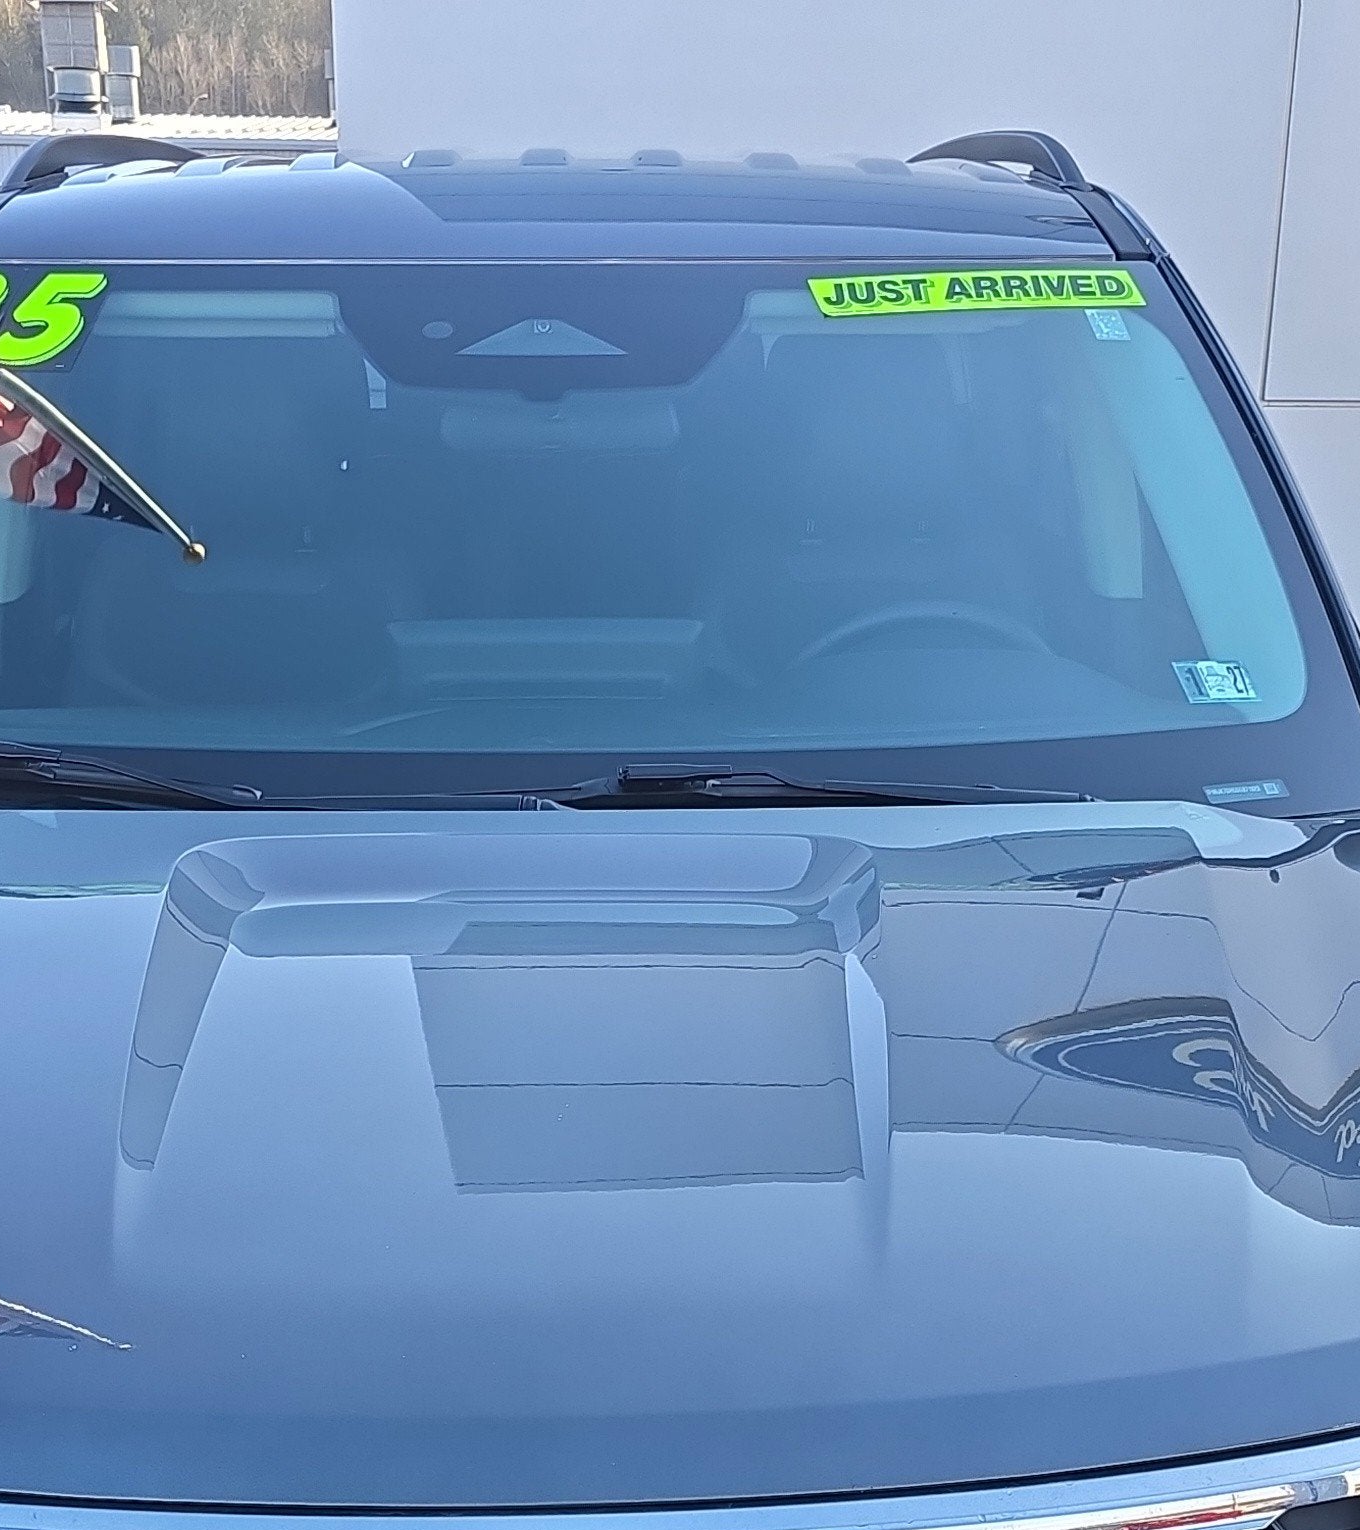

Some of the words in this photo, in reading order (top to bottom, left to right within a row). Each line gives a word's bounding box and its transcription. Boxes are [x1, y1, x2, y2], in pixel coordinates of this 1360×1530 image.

[823, 278, 934, 310] JUST
[944, 274, 1131, 301] ARRIVED
[1226, 665, 1250, 696] 27
